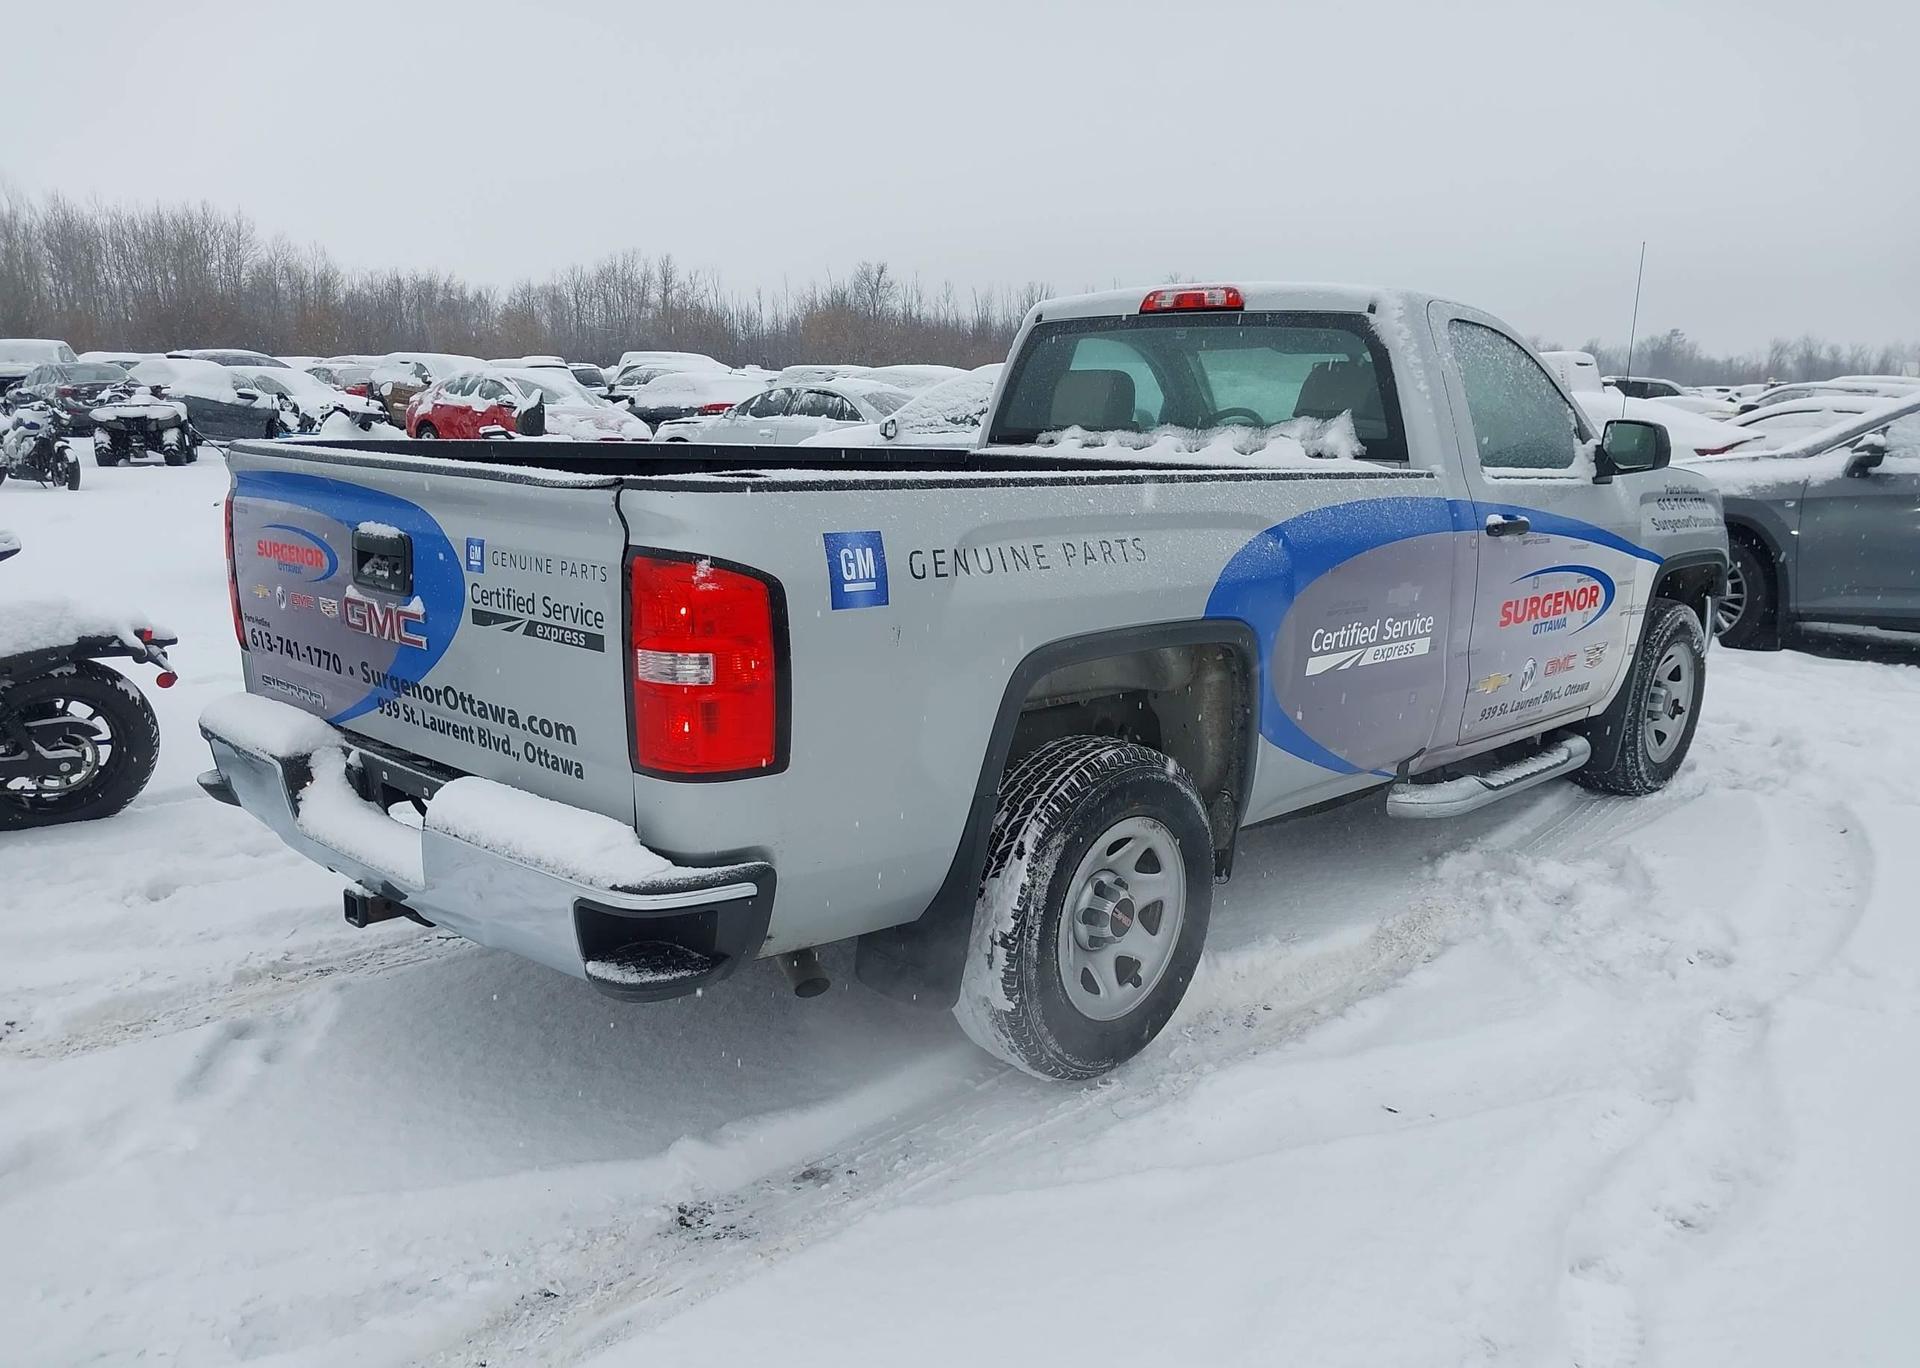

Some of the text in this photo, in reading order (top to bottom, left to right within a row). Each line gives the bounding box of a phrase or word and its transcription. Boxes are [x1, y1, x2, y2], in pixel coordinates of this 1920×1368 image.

[256, 540, 325, 569] SURGENOR
[469, 545, 481, 560] GM
[492, 551, 607, 583] GENUINE PARTS
[840, 547, 876, 581] GM
[909, 537, 1147, 580] GENUINE PARTS
[290, 592, 315, 608] GMC
[471, 582, 604, 629] Certified Service
[1500, 585, 1600, 628] SURGENOR
[343, 597, 428, 650] GMC
[536, 623, 586, 647] express
[1311, 612, 1434, 653] Certified Service
[1532, 617, 1568, 636] OTTAWA
[1373, 641, 1416, 662] express
[1543, 652, 1577, 677] GMC
[251, 628, 577, 746] 613-741-1770 SurgenorOttawa.com
[261, 673, 328, 709] SIERRA
[1479, 706, 1499, 722] 939
[1509, 694, 1543, 713] Laurent
[1564, 681, 1590, 698] Ottawa
[378, 698, 584, 780] 939 St. Laurent Blvd., Ottawa
